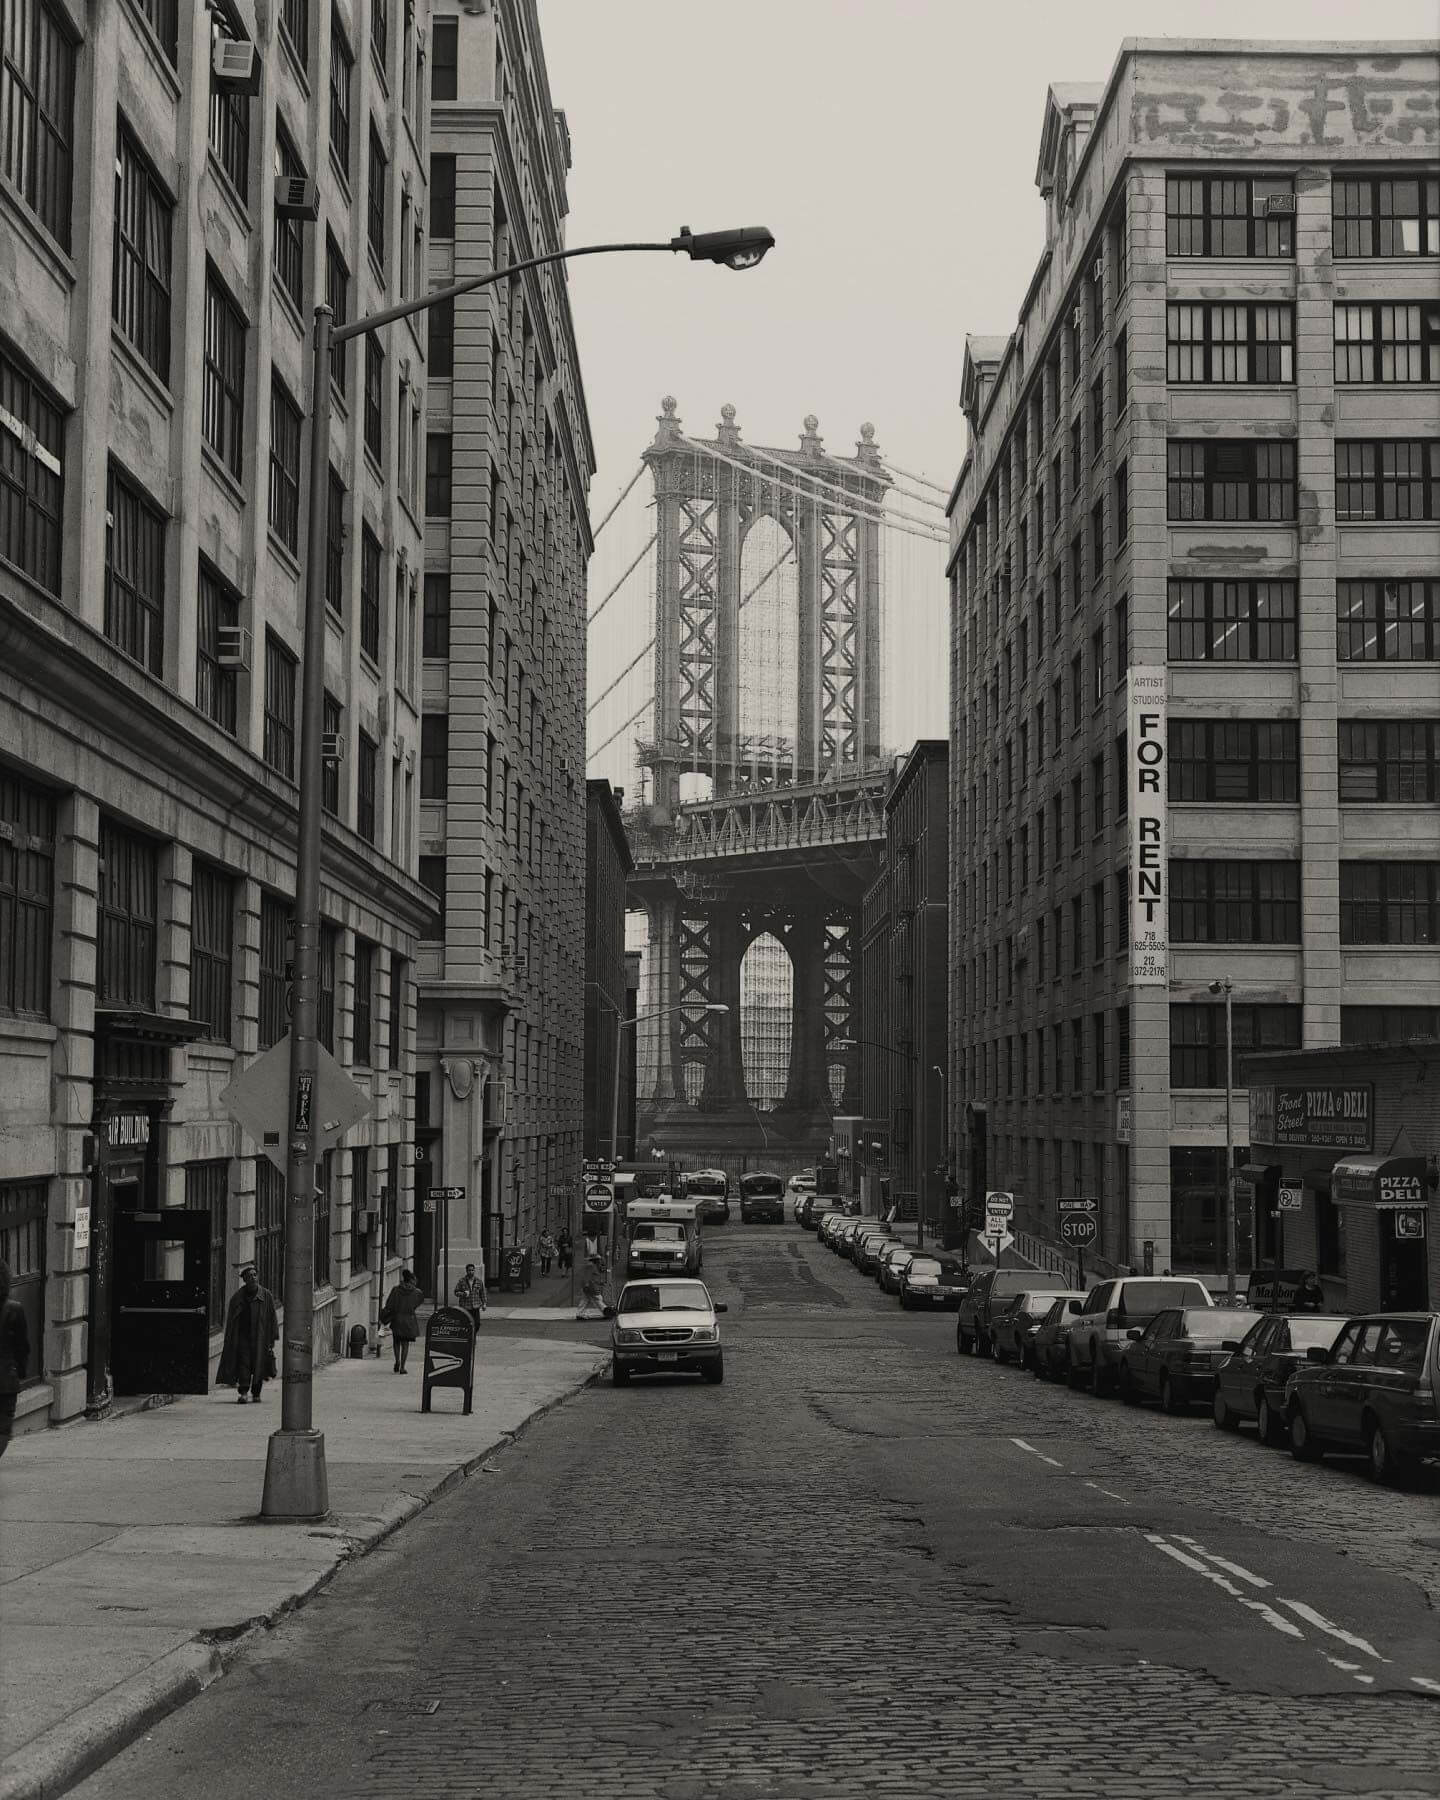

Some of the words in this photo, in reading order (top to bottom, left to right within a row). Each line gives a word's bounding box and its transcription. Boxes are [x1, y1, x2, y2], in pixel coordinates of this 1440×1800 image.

[1134, 677, 1163, 687] ARTIST
[1133, 695, 1165, 705] STUDIOS
[1137, 713, 1163, 793] FOR
[1138, 817, 1161, 922] RENT
[1143, 955, 1155, 966] 212
[1277, 1092, 1303, 1112] Front
[1306, 1090, 1335, 1117] PIZZA
[1343, 1091, 1368, 1118] DELI
[1277, 1112, 1304, 1130] Street
[120, 1115, 150, 1145] BUILDING
[415, 1146, 424, 1160] 6
[1380, 1176, 1421, 1188] PIZZA
[1380, 1189, 1422, 1200] DELI
[1063, 1223, 1095, 1236] STOP
